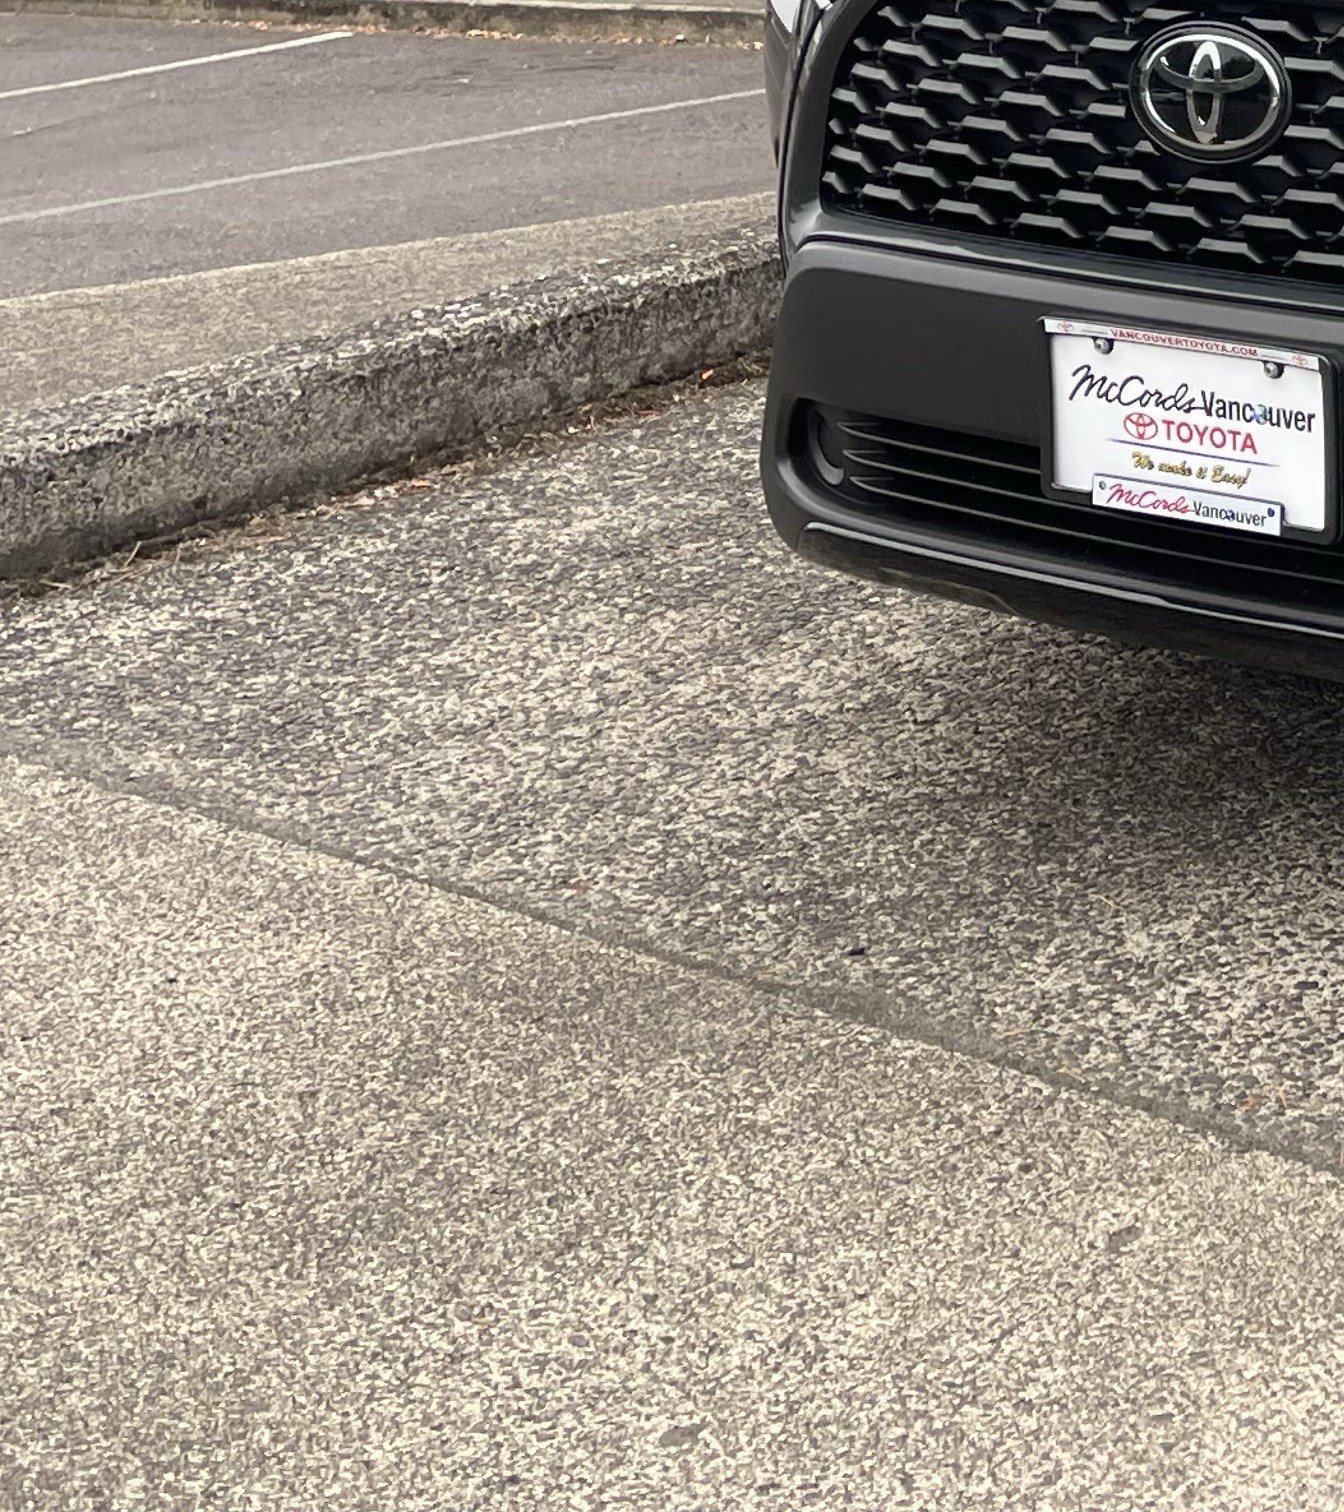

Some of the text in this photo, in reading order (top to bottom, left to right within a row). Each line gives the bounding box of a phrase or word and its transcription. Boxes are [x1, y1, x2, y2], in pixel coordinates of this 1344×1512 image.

[1109, 328, 1259, 357] VANCOUVERTOYOTA.COM
[1161, 419, 1258, 455] TOYOTA
[1158, 460, 1192, 477] make
